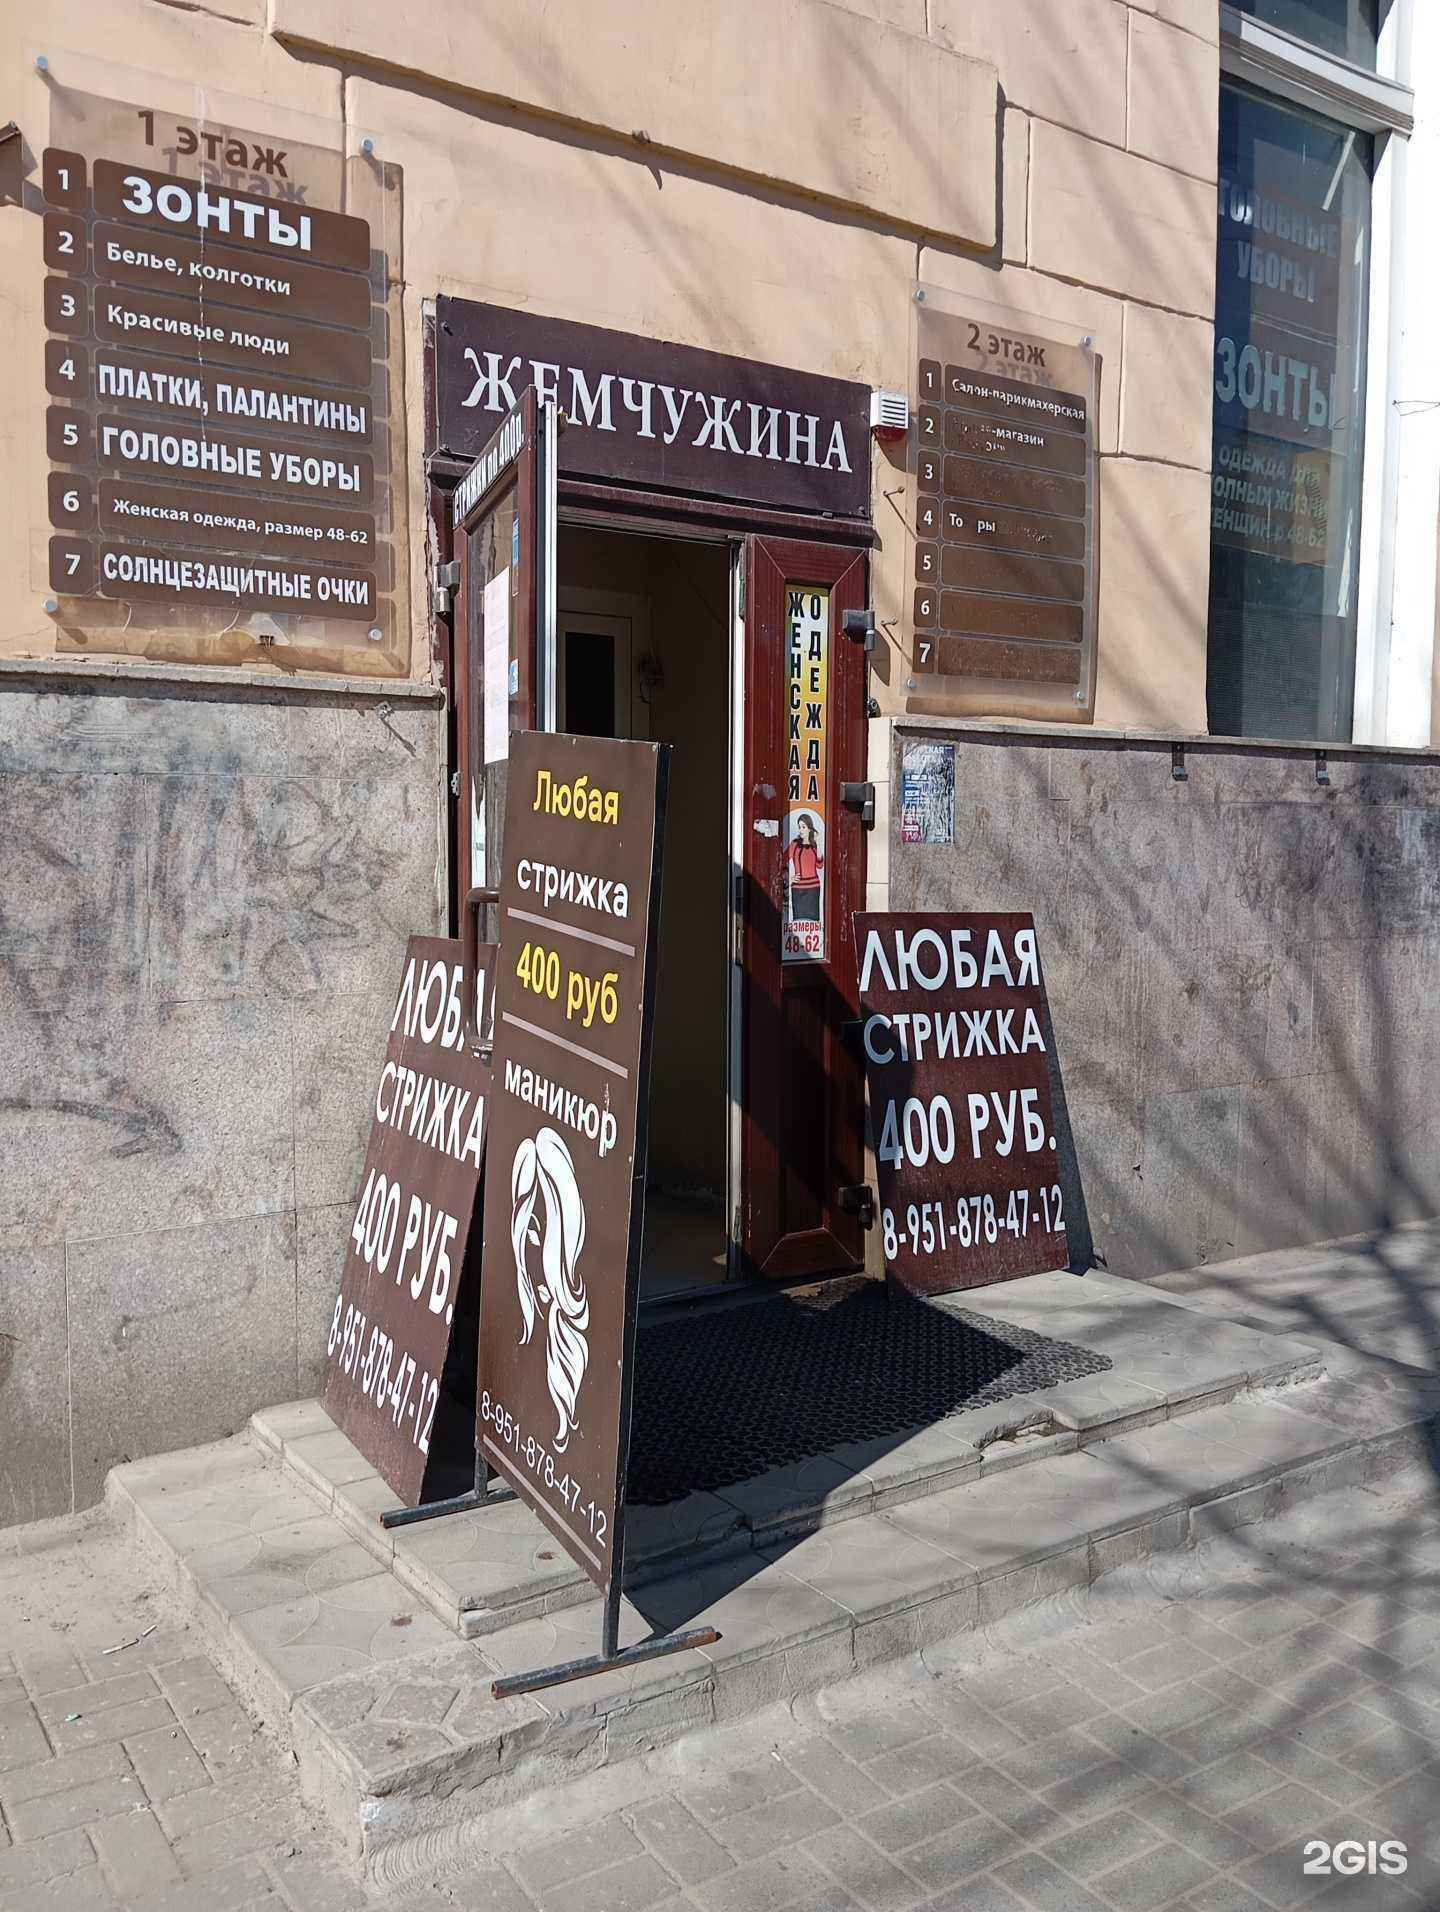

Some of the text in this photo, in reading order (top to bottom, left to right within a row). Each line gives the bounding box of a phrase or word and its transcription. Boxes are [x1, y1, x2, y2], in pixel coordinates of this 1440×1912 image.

[137, 110, 289, 179] 1 этаж
[58, 169, 312, 251] 1 ЗОНТЫ
[58, 231, 291, 296] 2 Белье, колготки
[1237, 239, 1315, 303] УБОРЫ
[60, 295, 290, 355] 3 Красивые люди
[967, 323, 1046, 368] 2 этаж
[59, 360, 367, 434] 4 ПЛАТКИ, ПАЛАНТИНЫ
[462, 346, 853, 474] ЖЕМЧУЖИНА
[926, 372, 1085, 421] 1 Салон-парикмахерская
[1215, 337, 1336, 432] ЗОНТЫ
[924, 418, 935, 434] 2
[63, 425, 360, 492] 5 ГОЛОВНЫЕ УБОРЫ
[924, 463, 934, 480] 3
[1214, 475, 1272, 506] ОЛНЫХ
[63, 491, 368, 545] 6 Женская одежда, размер 48-62
[923, 510, 933, 527] 4
[1212, 507, 1271, 538] ЕНЩИН
[64, 552, 368, 606] 7 СОЛНЦЕЗАЩИТНЫЕ ОЧКИ
[922, 555, 932, 571] 5
[921, 600, 931, 616] 6
[919, 643, 931, 663] 7
[788, 591, 805, 801] ЖЕНСКАЯ
[806, 593, 822, 802] ОДЕЖДА
[533, 770, 619, 825] Любая
[517, 858, 629, 919] стрижка
[784, 920, 821, 934] размеры
[785, 934, 820, 954] 48-62
[516, 942, 619, 1029] 400 руб
[859, 928, 1039, 992] ЛЮБАЯ
[391, 958, 497, 1052] ЛЮБ
[864, 1007, 1046, 1064] СТРИЖКА
[376, 1061, 484, 1169] СТРИЖКА
[504, 1058, 617, 1158] маникюр
[879, 1087, 1056, 1170] 400 РУБ.
[352, 1168, 458, 1326] 400 РУБ.
[883, 1184, 1066, 1261] 8-951-878-47-12
[327, 1293, 440, 1455] 8-951-878-47-12
[481, 1390, 607, 1547] 8-951-878-47-12
